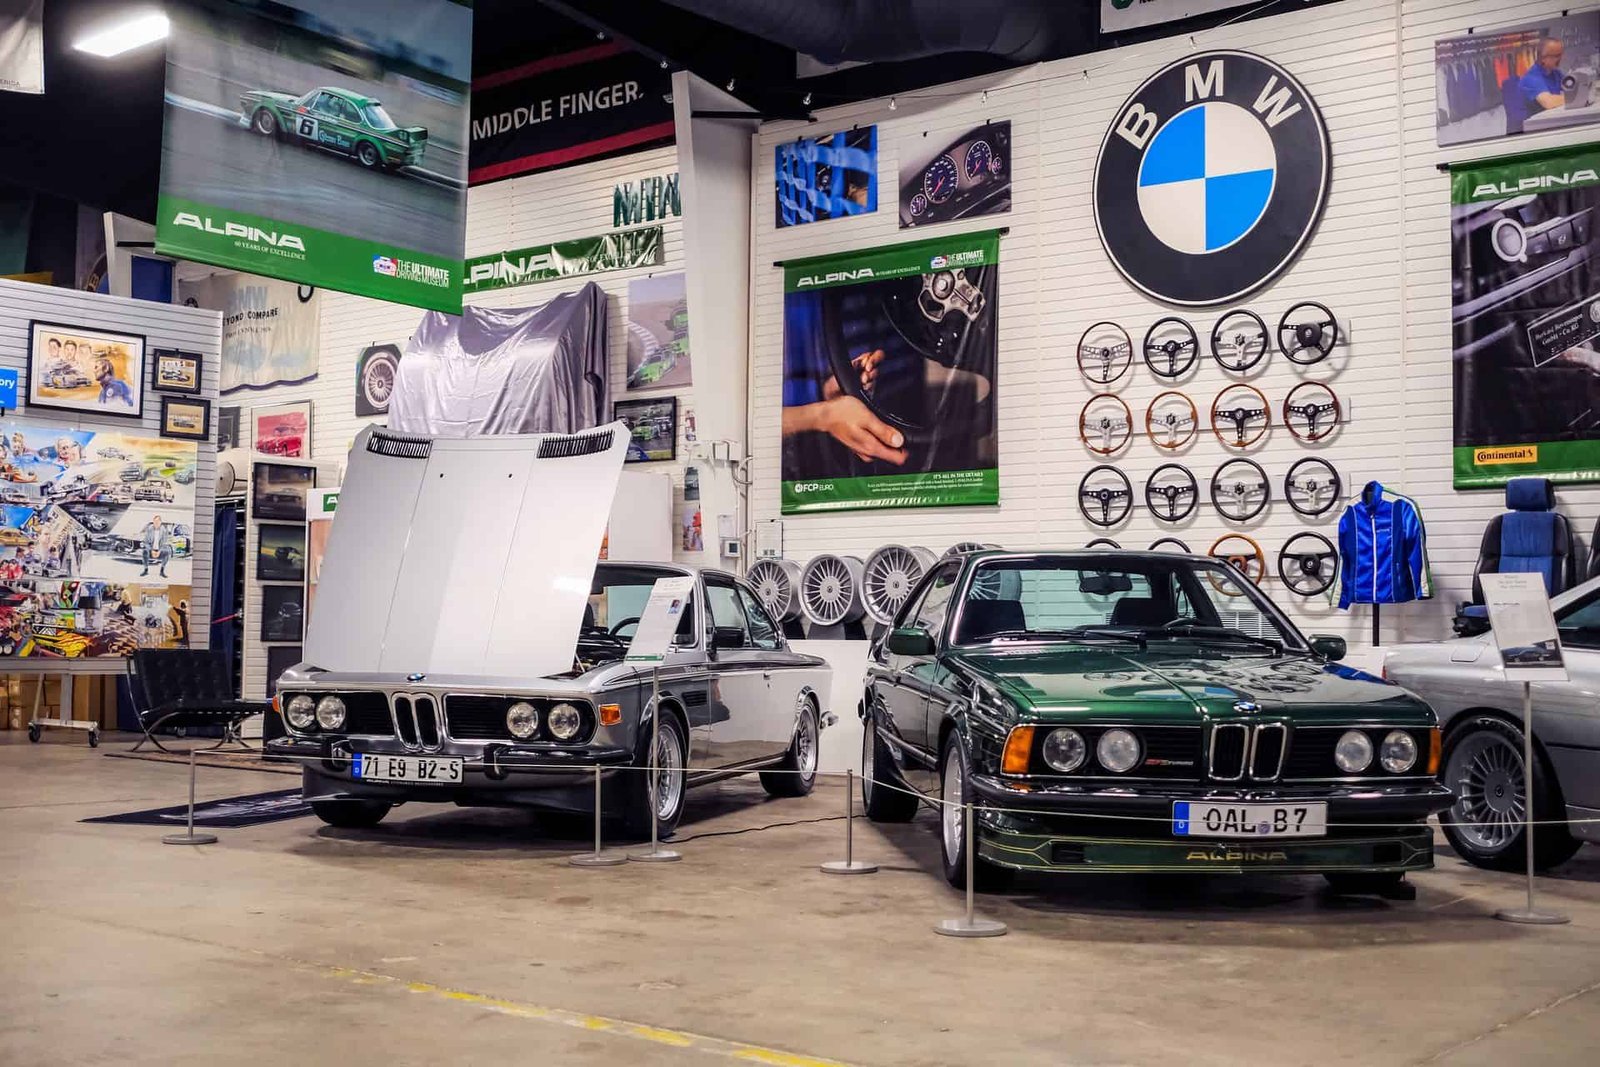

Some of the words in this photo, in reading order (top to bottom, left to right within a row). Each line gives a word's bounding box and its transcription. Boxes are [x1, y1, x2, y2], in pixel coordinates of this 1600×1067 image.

[1115, 59, 1302, 150] BMW
[300, 118, 315, 136] 6
[472, 99, 553, 141] MIDDLE
[1472, 169, 1600, 198] ALPINA
[173, 212, 306, 252] ALPINA
[241, 241, 261, 251] YEARS
[261, 246, 269, 254] OF
[270, 247, 306, 261] EXCELLENCE
[397, 259, 411, 272] THE
[411, 262, 450, 280] ULTIMATE
[797, 268, 875, 288] ALPINA
[421, 275, 450, 288] MUSEUM
[247, 307, 279, 320] COMPARE
[1477, 449, 1526, 463] Continental
[803, 483, 819, 492] FCP
[364, 756, 379, 777] 71
[388, 758, 407, 779] E9
[1206, 808, 1257, 833] OAL
[1186, 851, 1288, 861] ALPINA
